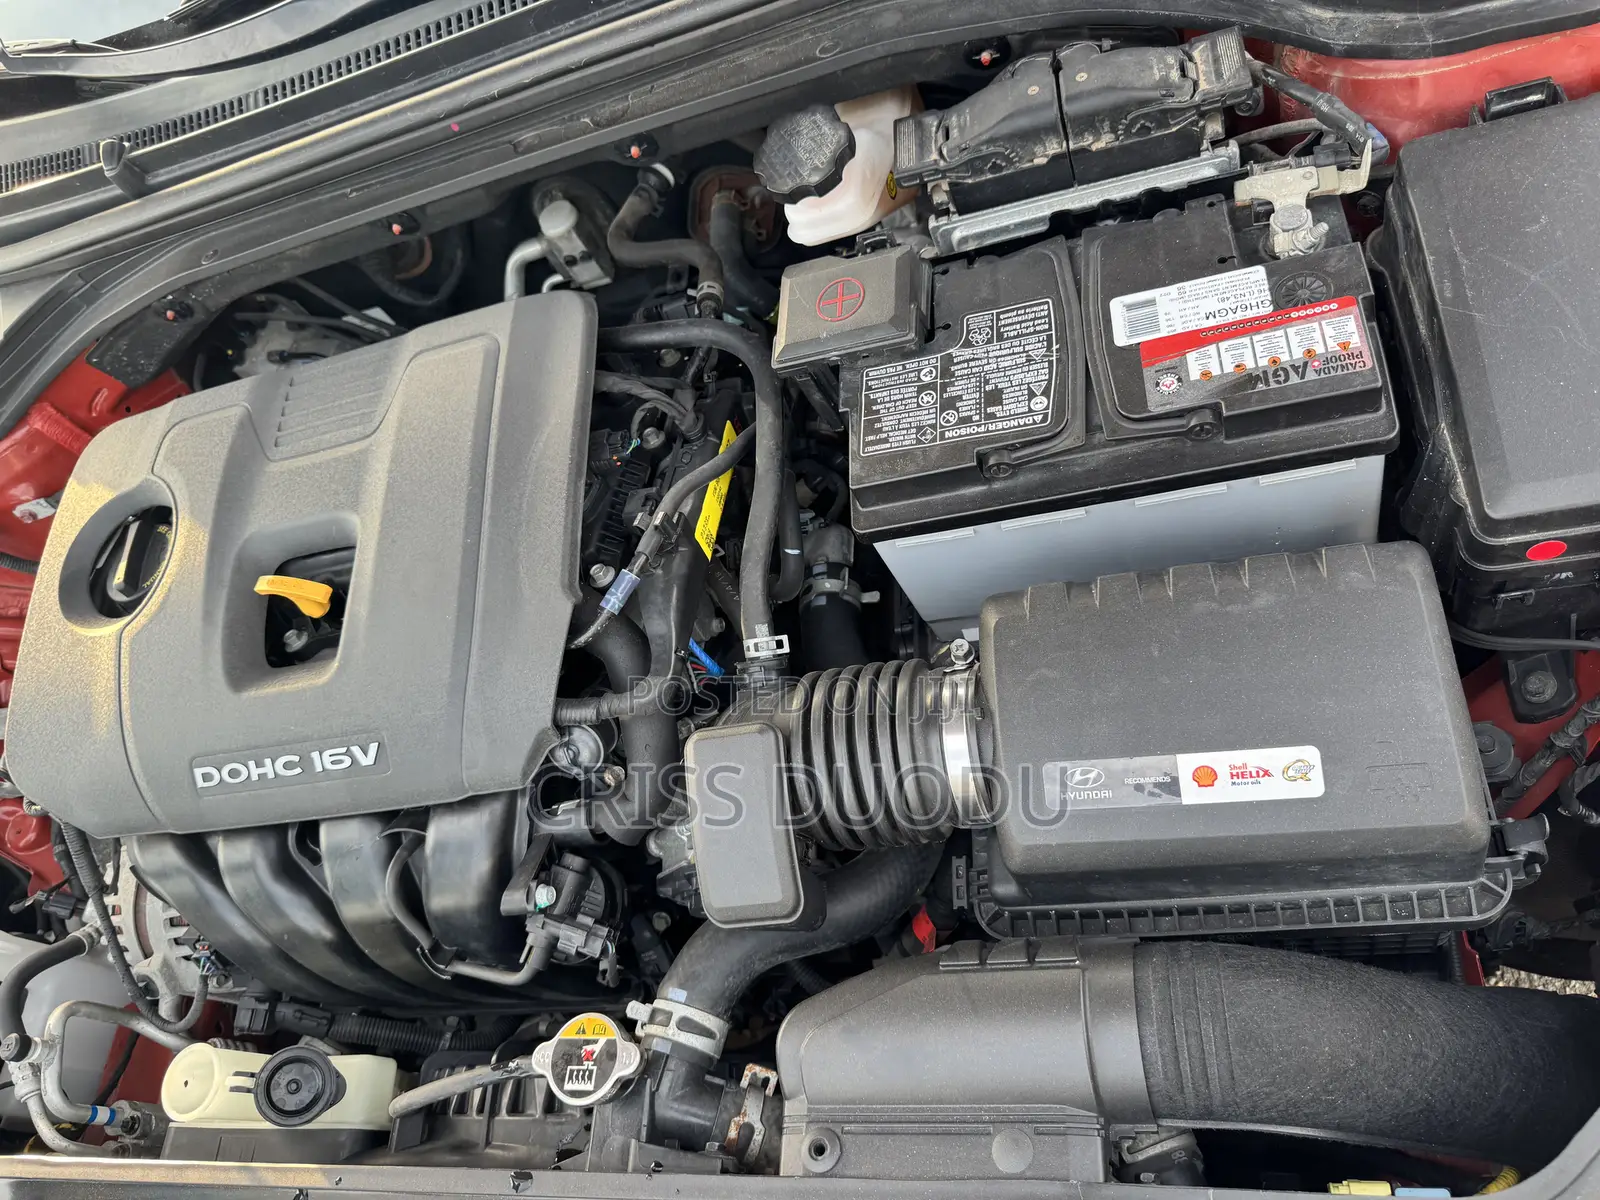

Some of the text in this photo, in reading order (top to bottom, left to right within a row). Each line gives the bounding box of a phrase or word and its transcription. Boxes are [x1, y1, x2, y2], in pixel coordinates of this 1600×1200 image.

[1205, 299, 1272, 320] GH6AGM
[1322, 350, 1363, 366] PROOF
[1313, 360, 1366, 376] CANADA
[945, 416, 1033, 438] DANGER/POISON
[193, 742, 380, 789] DOHC 16V
[1229, 763, 1247, 771] Shell
[1124, 776, 1171, 784] RECOMMENDS
[1229, 768, 1273, 780] HELIX
[1060, 790, 1112, 800] HYUNDAI
